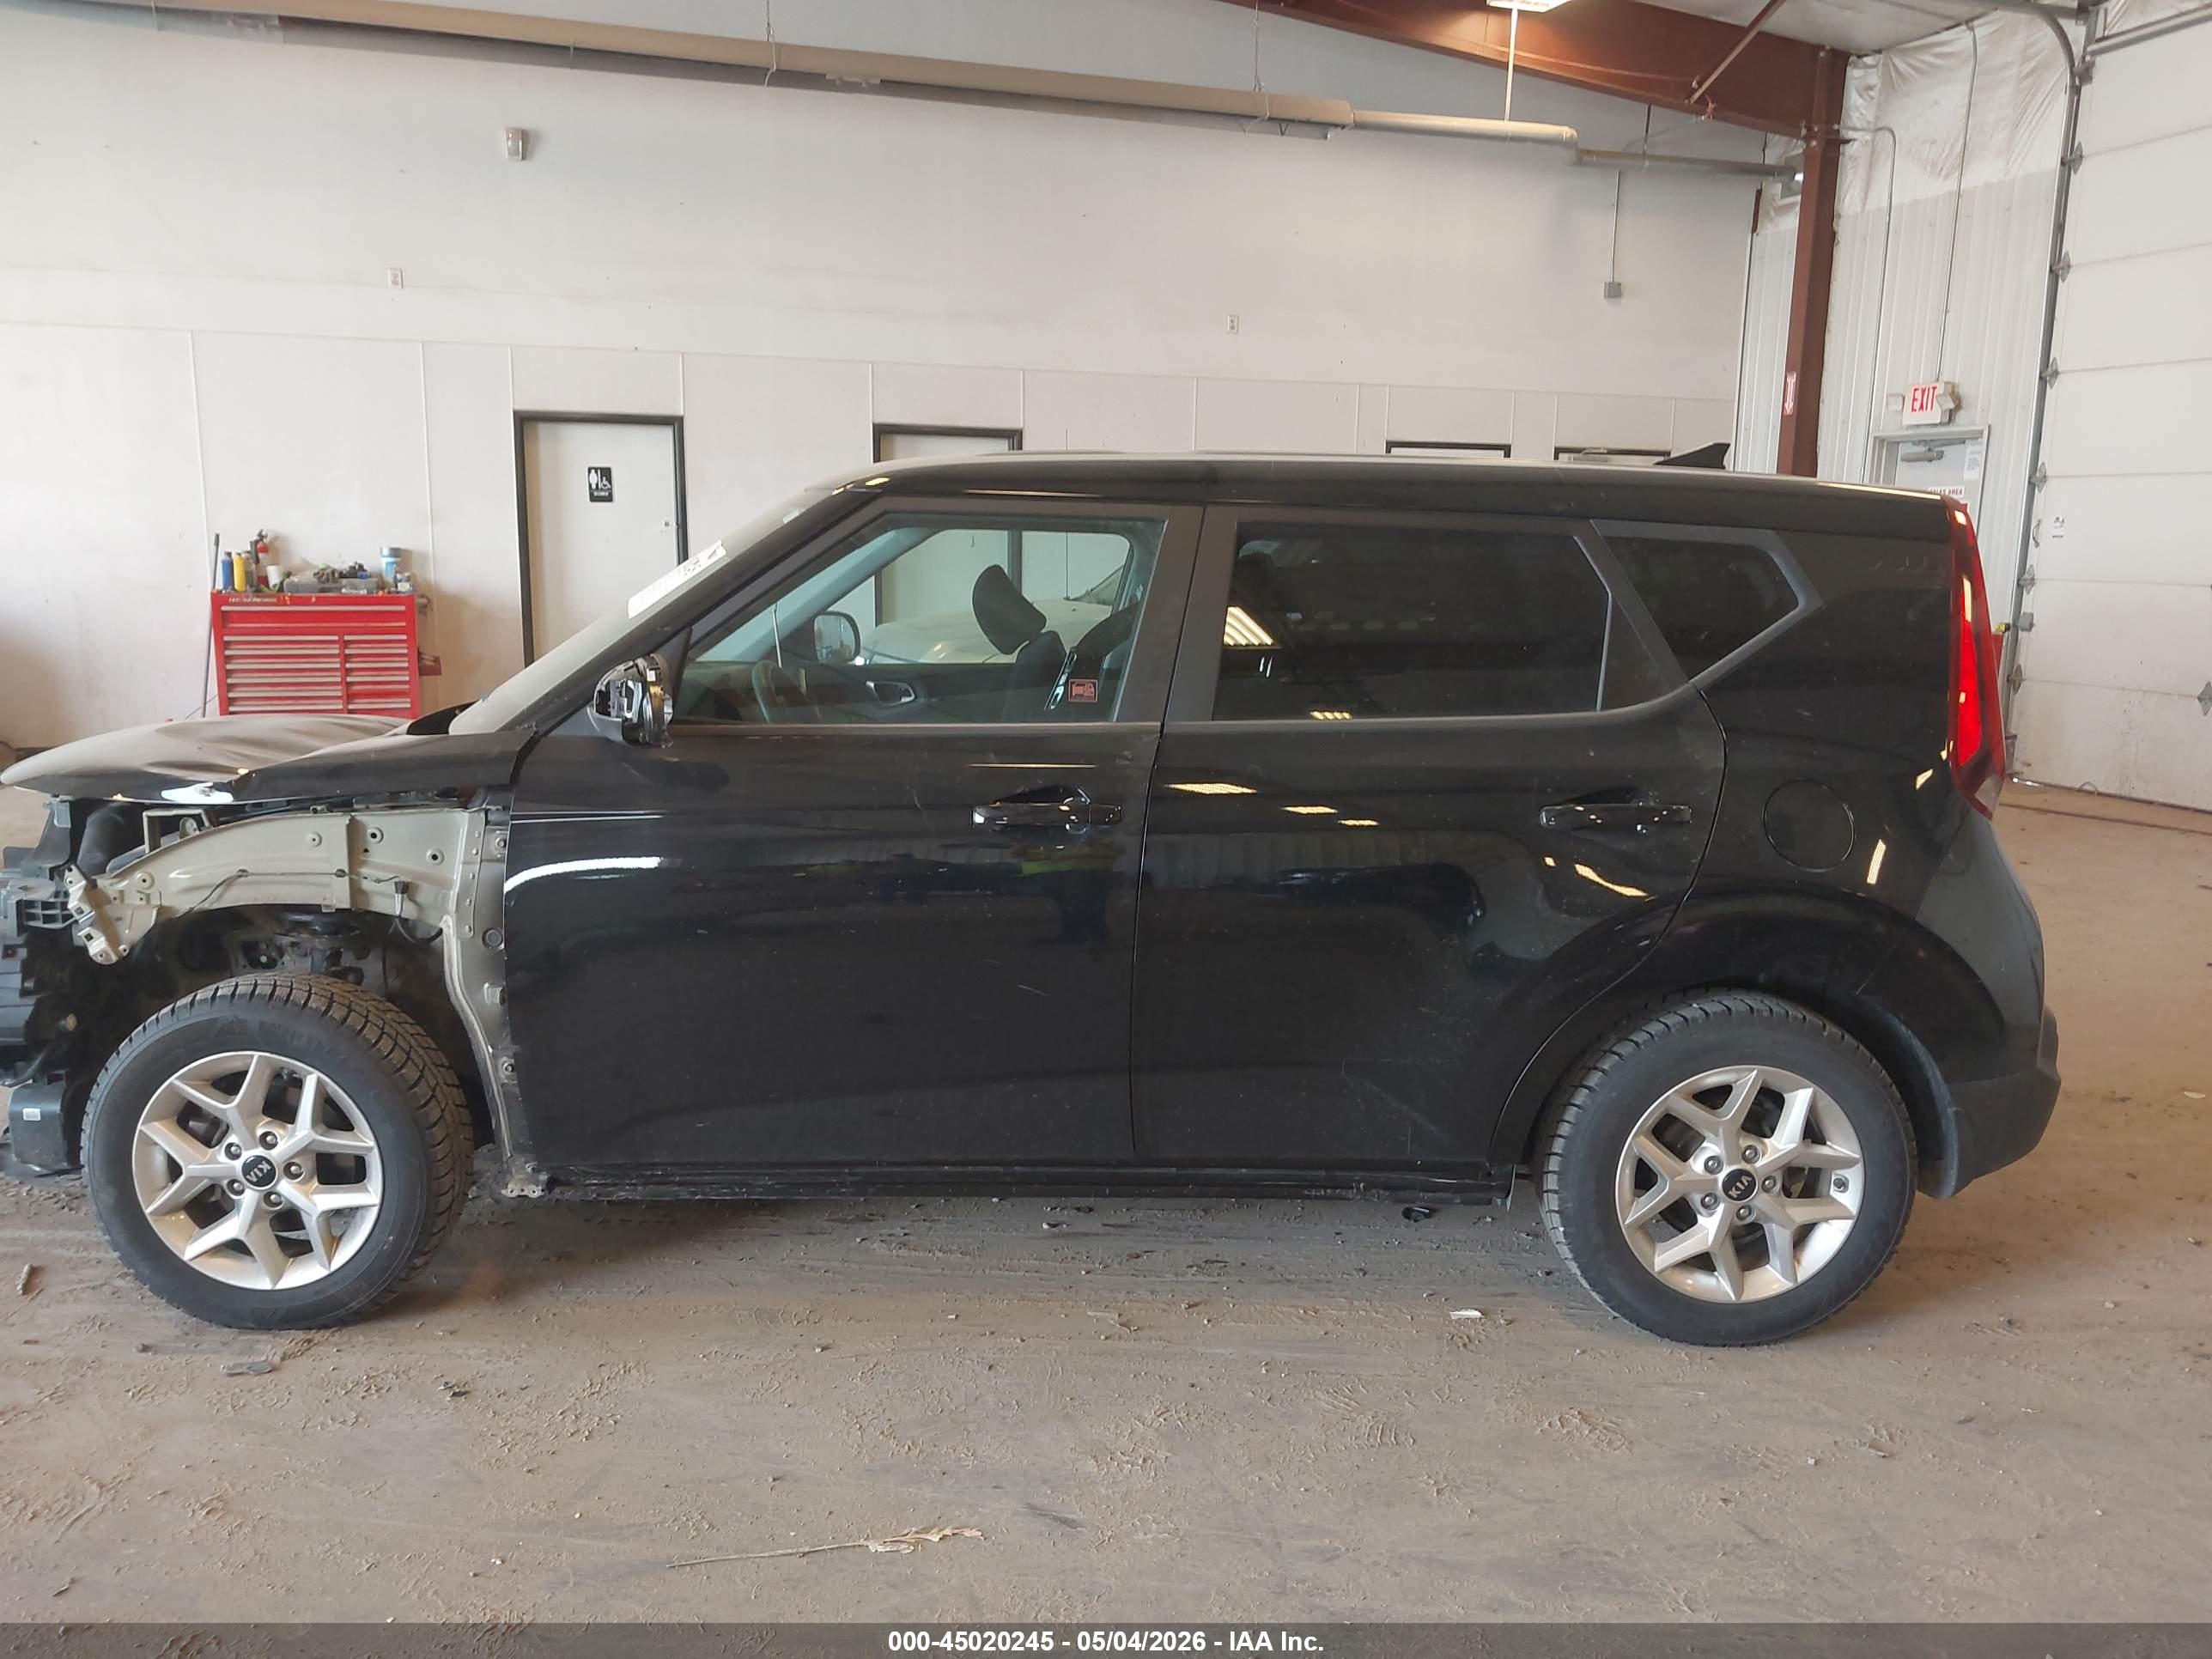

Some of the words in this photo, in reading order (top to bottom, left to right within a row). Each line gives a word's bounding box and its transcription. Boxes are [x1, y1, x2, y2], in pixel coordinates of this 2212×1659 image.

[1911, 386, 1937, 412] EXIT
[246, 1160, 272, 1182] KIA
[1728, 1175, 1753, 1198] KIA
